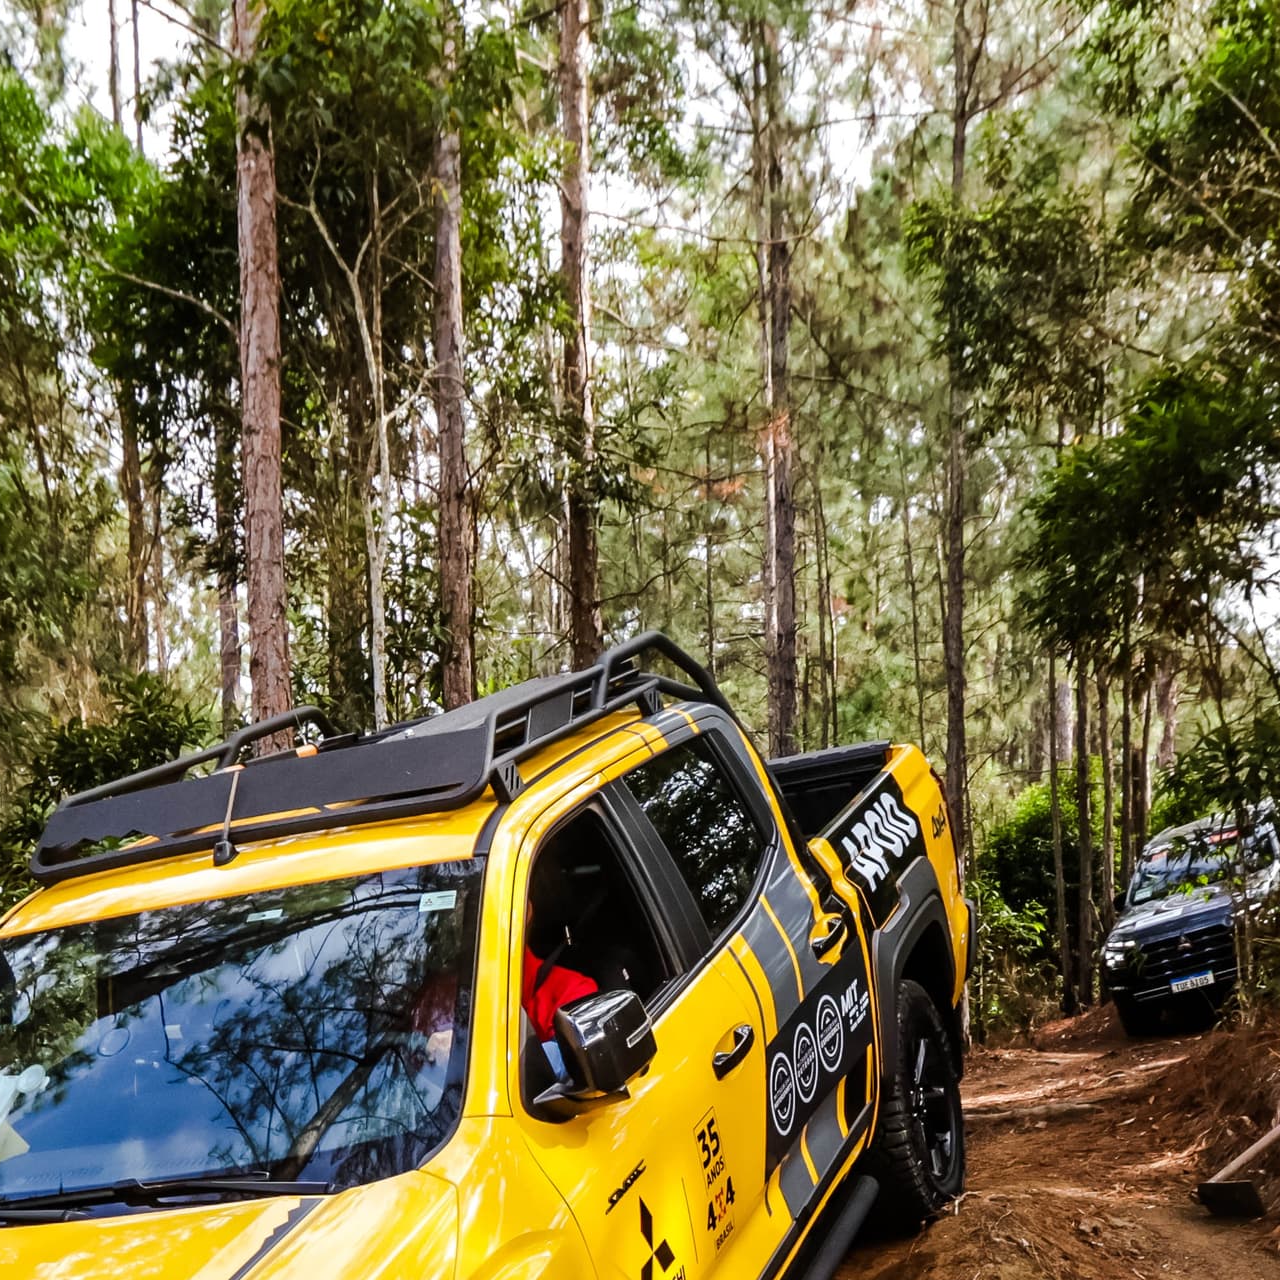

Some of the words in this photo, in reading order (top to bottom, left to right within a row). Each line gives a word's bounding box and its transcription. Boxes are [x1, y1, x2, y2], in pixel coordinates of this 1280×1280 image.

[841, 792, 918, 893] APOIO
[697, 1117, 720, 1169] 35
[706, 1155, 725, 1189] ANOS
[715, 1220, 734, 1251] BRASIL
